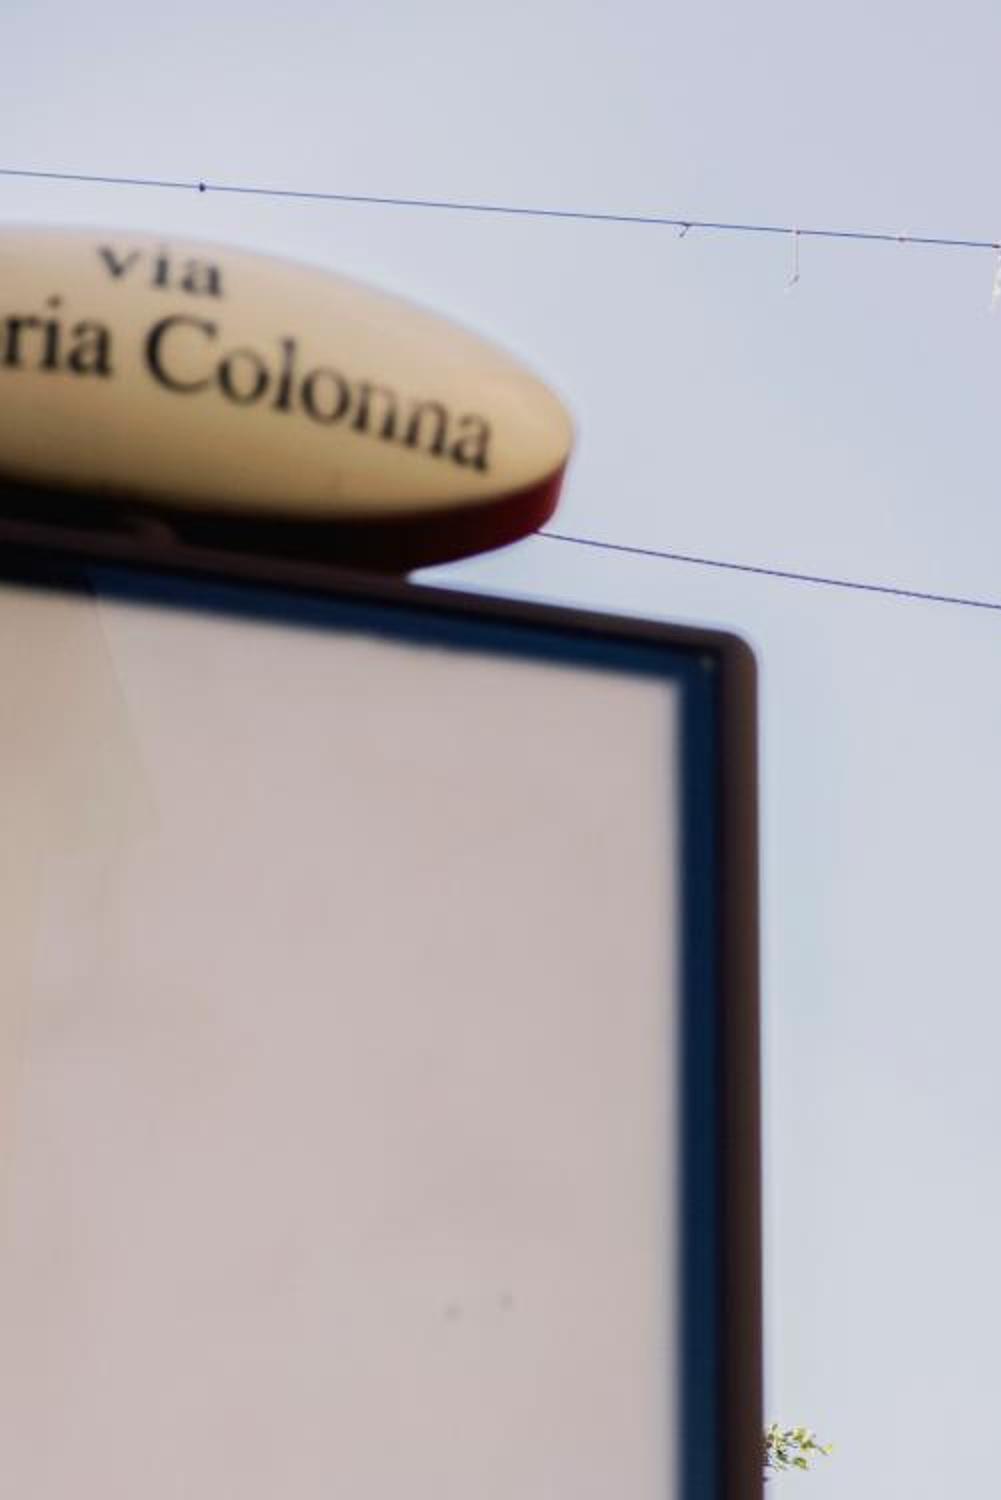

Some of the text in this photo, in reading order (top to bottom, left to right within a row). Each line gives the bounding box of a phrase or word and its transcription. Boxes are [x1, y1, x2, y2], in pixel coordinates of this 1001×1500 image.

[98, 246, 222, 298] via
[0, 294, 491, 472] ria Colonna
